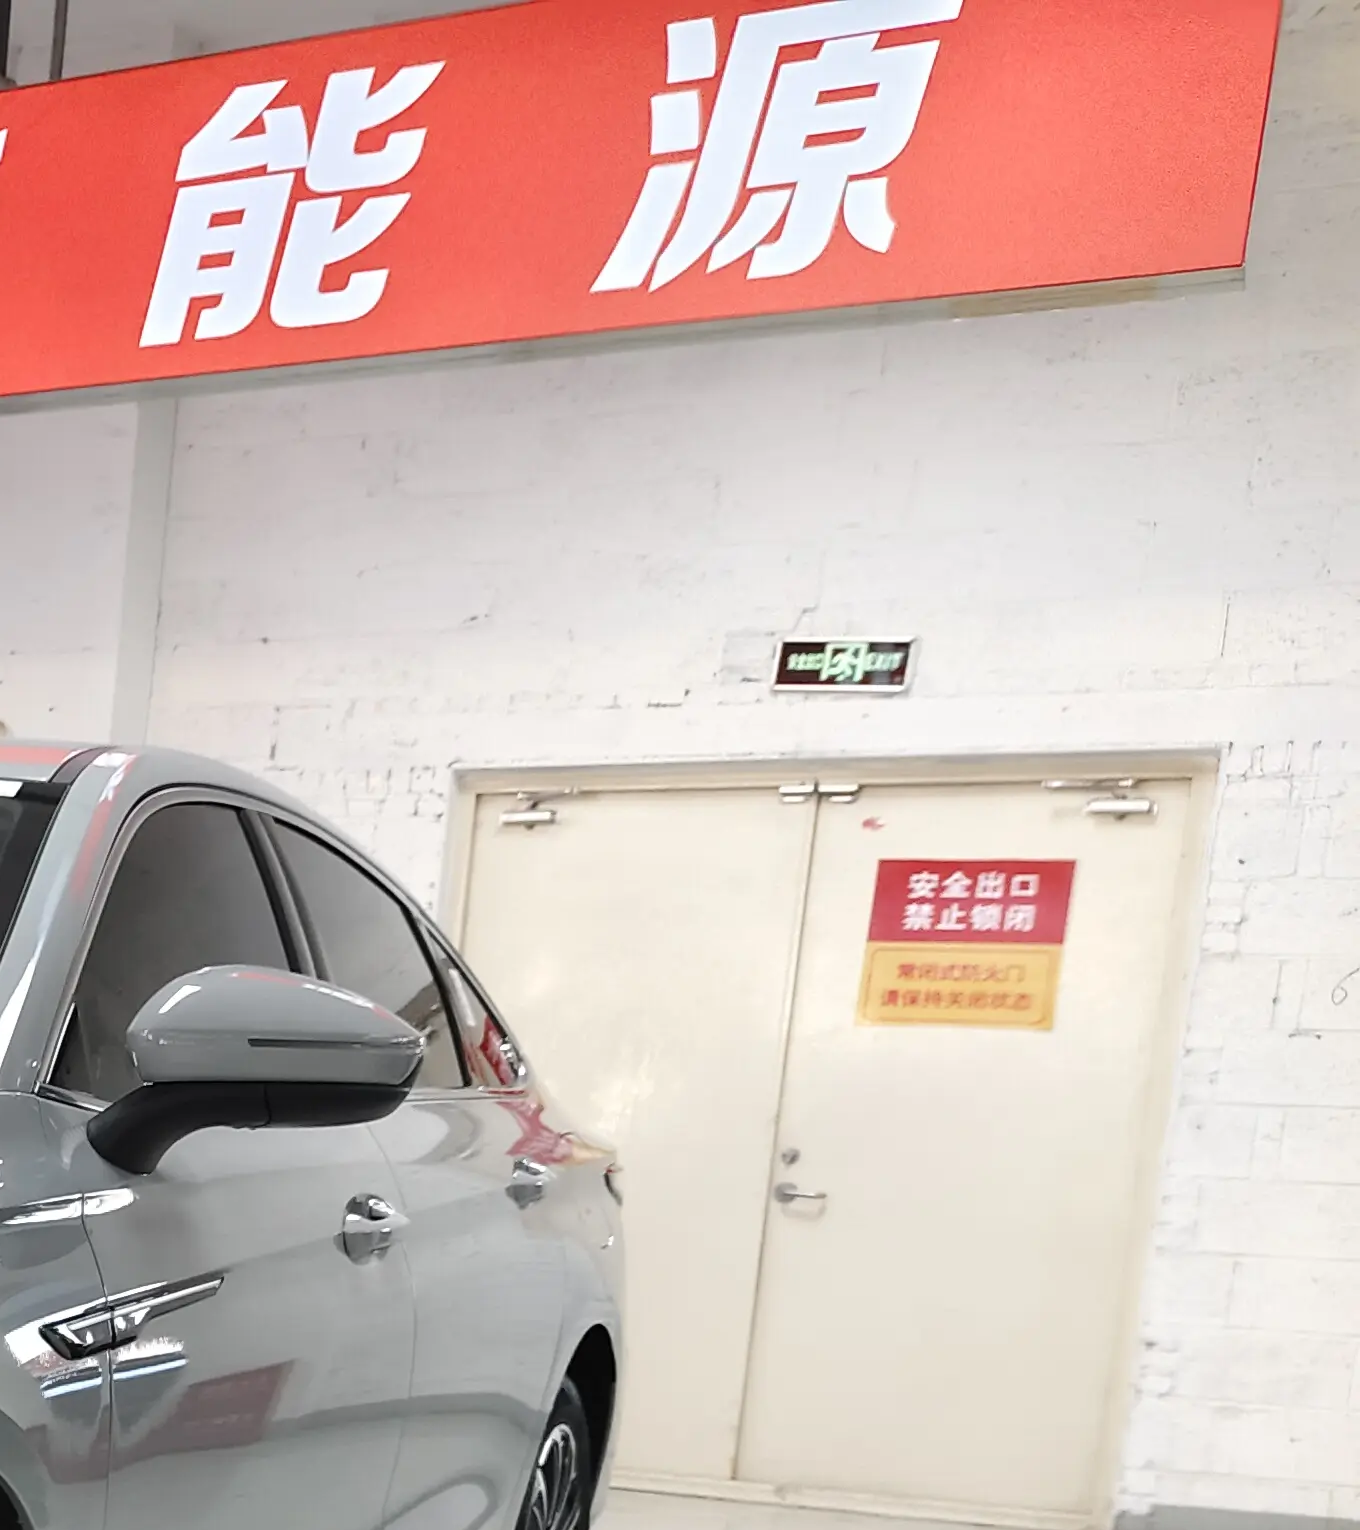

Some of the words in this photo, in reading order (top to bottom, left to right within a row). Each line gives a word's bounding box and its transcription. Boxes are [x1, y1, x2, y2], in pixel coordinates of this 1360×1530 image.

[907, 870, 1040, 899] 安全出口
[901, 902, 1037, 932] 禁止锁闭
